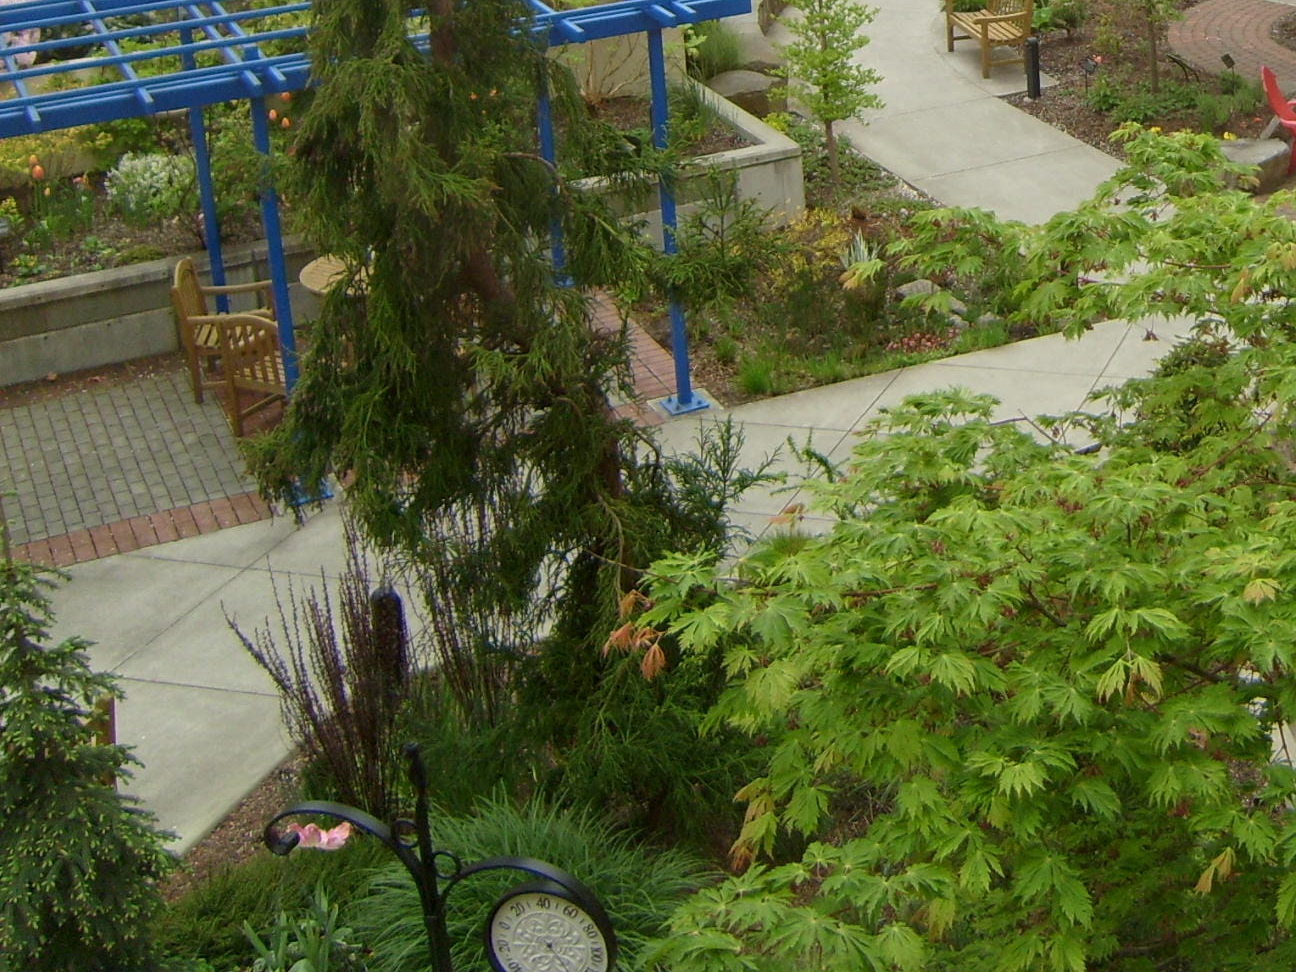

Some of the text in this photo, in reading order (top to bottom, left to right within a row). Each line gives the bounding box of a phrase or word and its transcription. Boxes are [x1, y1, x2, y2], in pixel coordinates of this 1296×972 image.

[510, 901, 526, 917] 20
[536, 897, 551, 910] 40
[562, 905, 579, 918] 60
[498, 921, 511, 931] 0
[583, 923, 598, 939] 80
